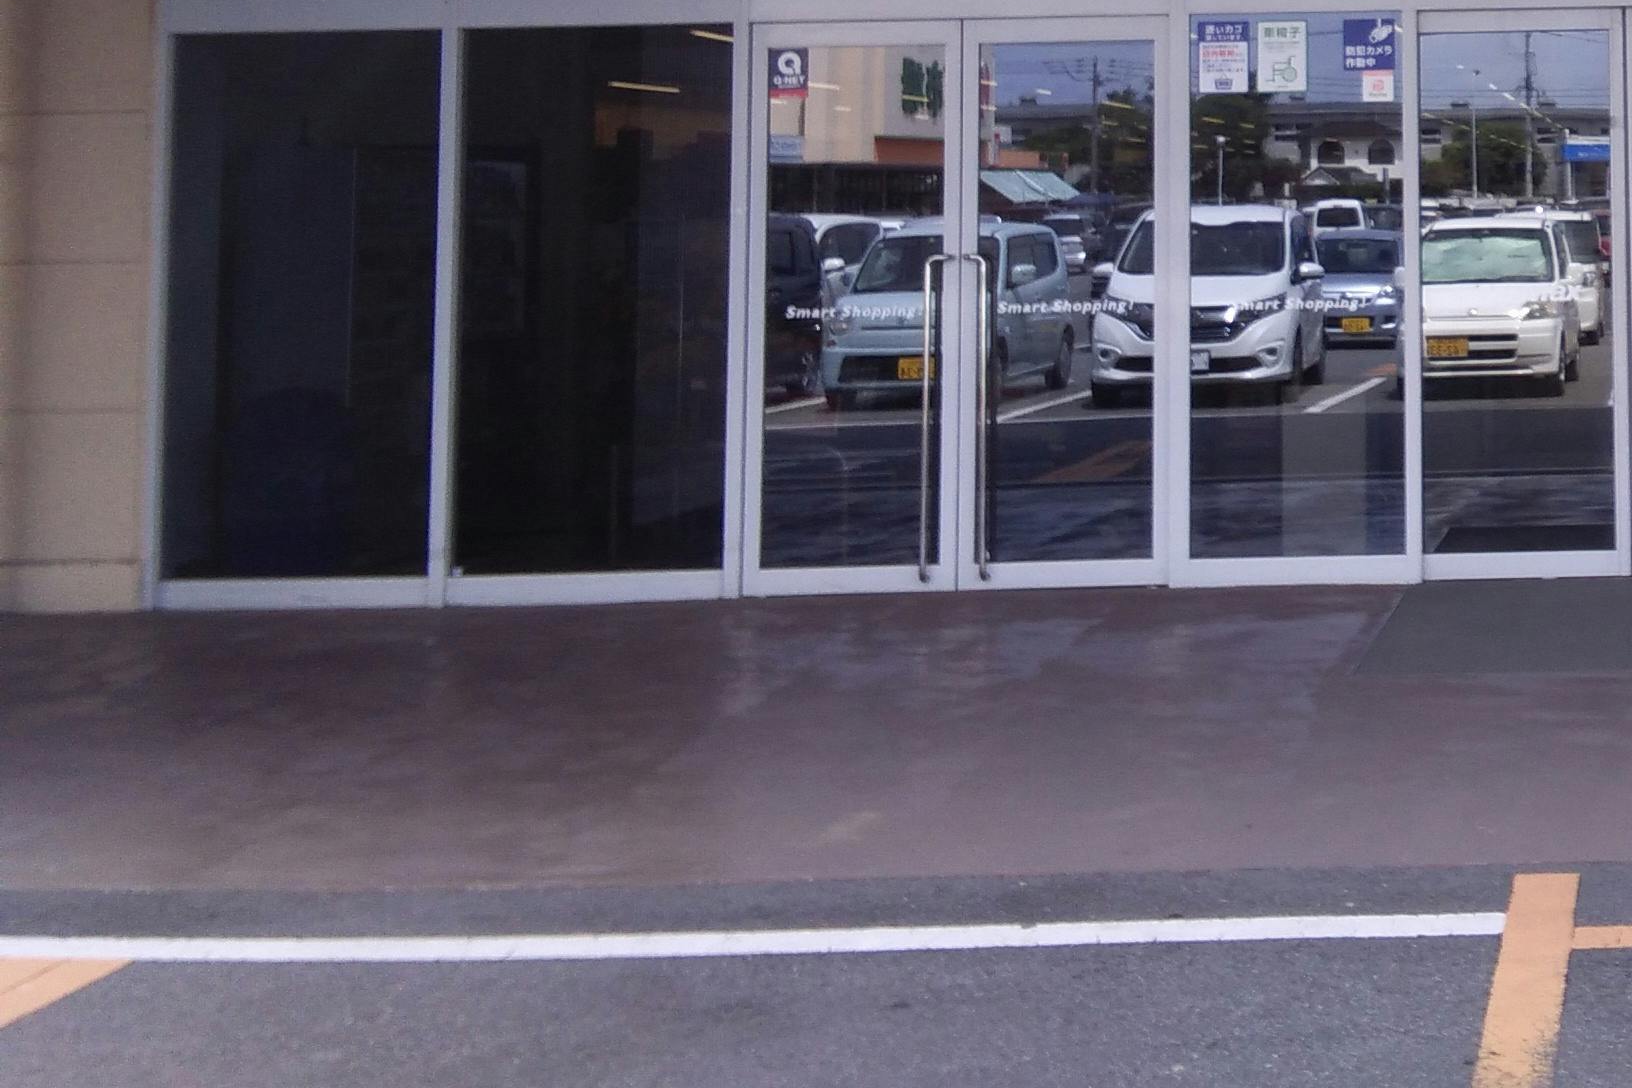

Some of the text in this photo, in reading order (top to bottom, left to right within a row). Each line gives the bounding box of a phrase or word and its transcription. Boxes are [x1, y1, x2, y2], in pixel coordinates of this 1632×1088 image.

[1345, 45, 1393, 57] 防犯カメラ
[1345, 57, 1376, 68] 作動中
[785, 304, 923, 320] Smart Shopping!
[997, 298, 1134, 315] Smart Shopping!
